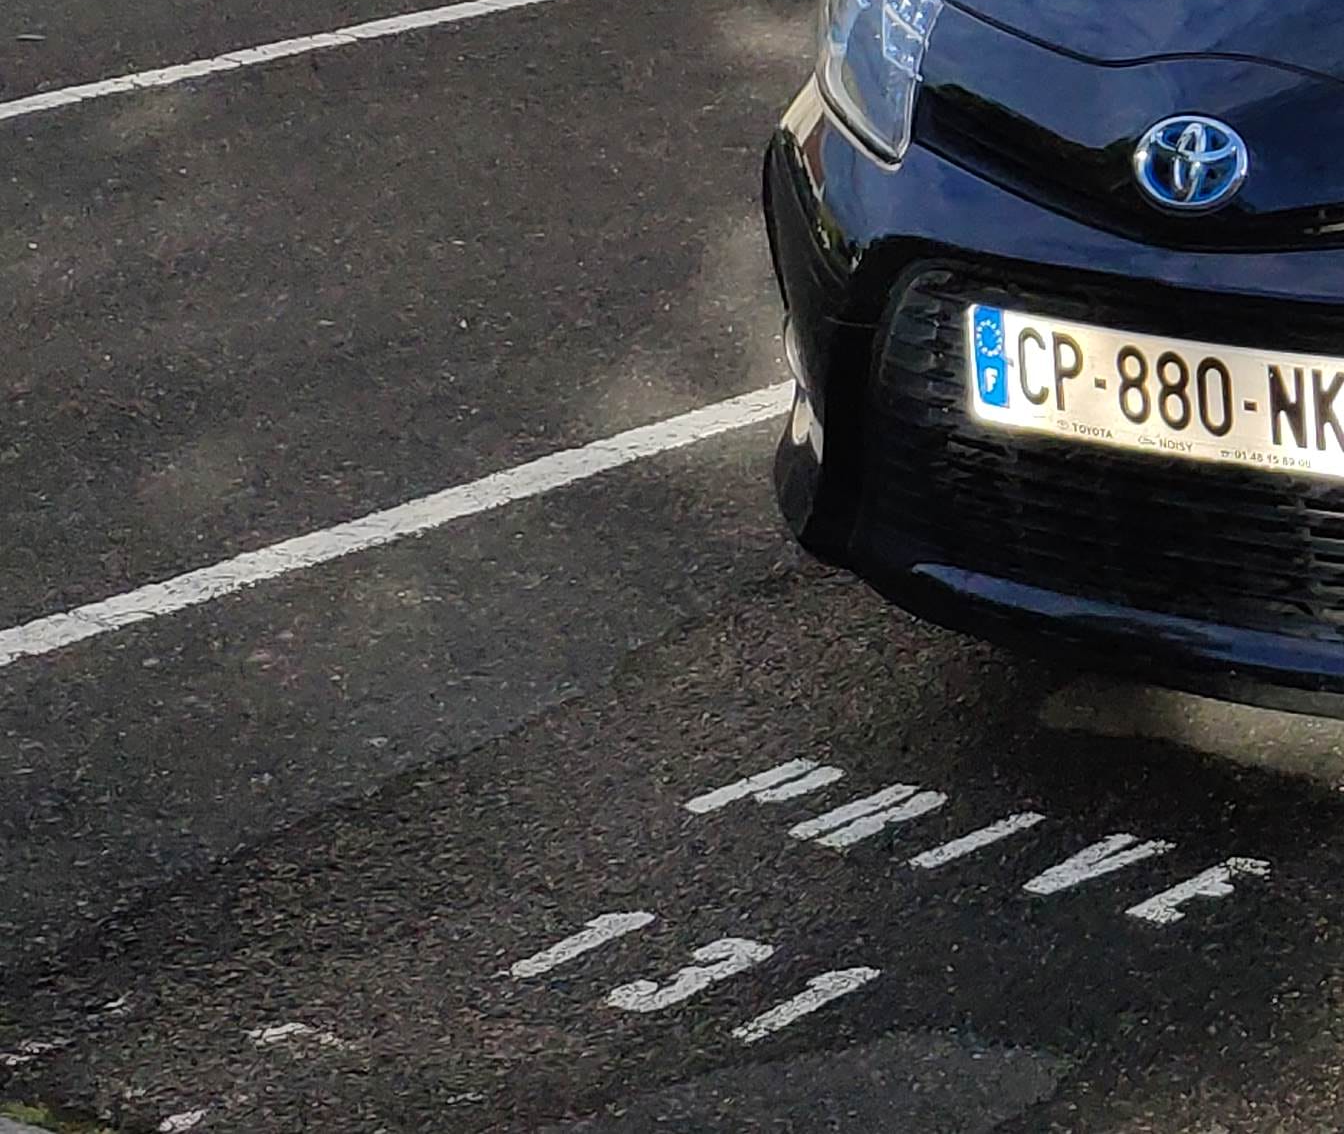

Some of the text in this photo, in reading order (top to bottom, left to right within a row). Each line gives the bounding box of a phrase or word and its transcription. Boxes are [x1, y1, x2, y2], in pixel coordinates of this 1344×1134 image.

[985, 367, 998, 394] F
[1072, 422, 1114, 439] TOYOTA
[510, 911, 881, 1045] 131
